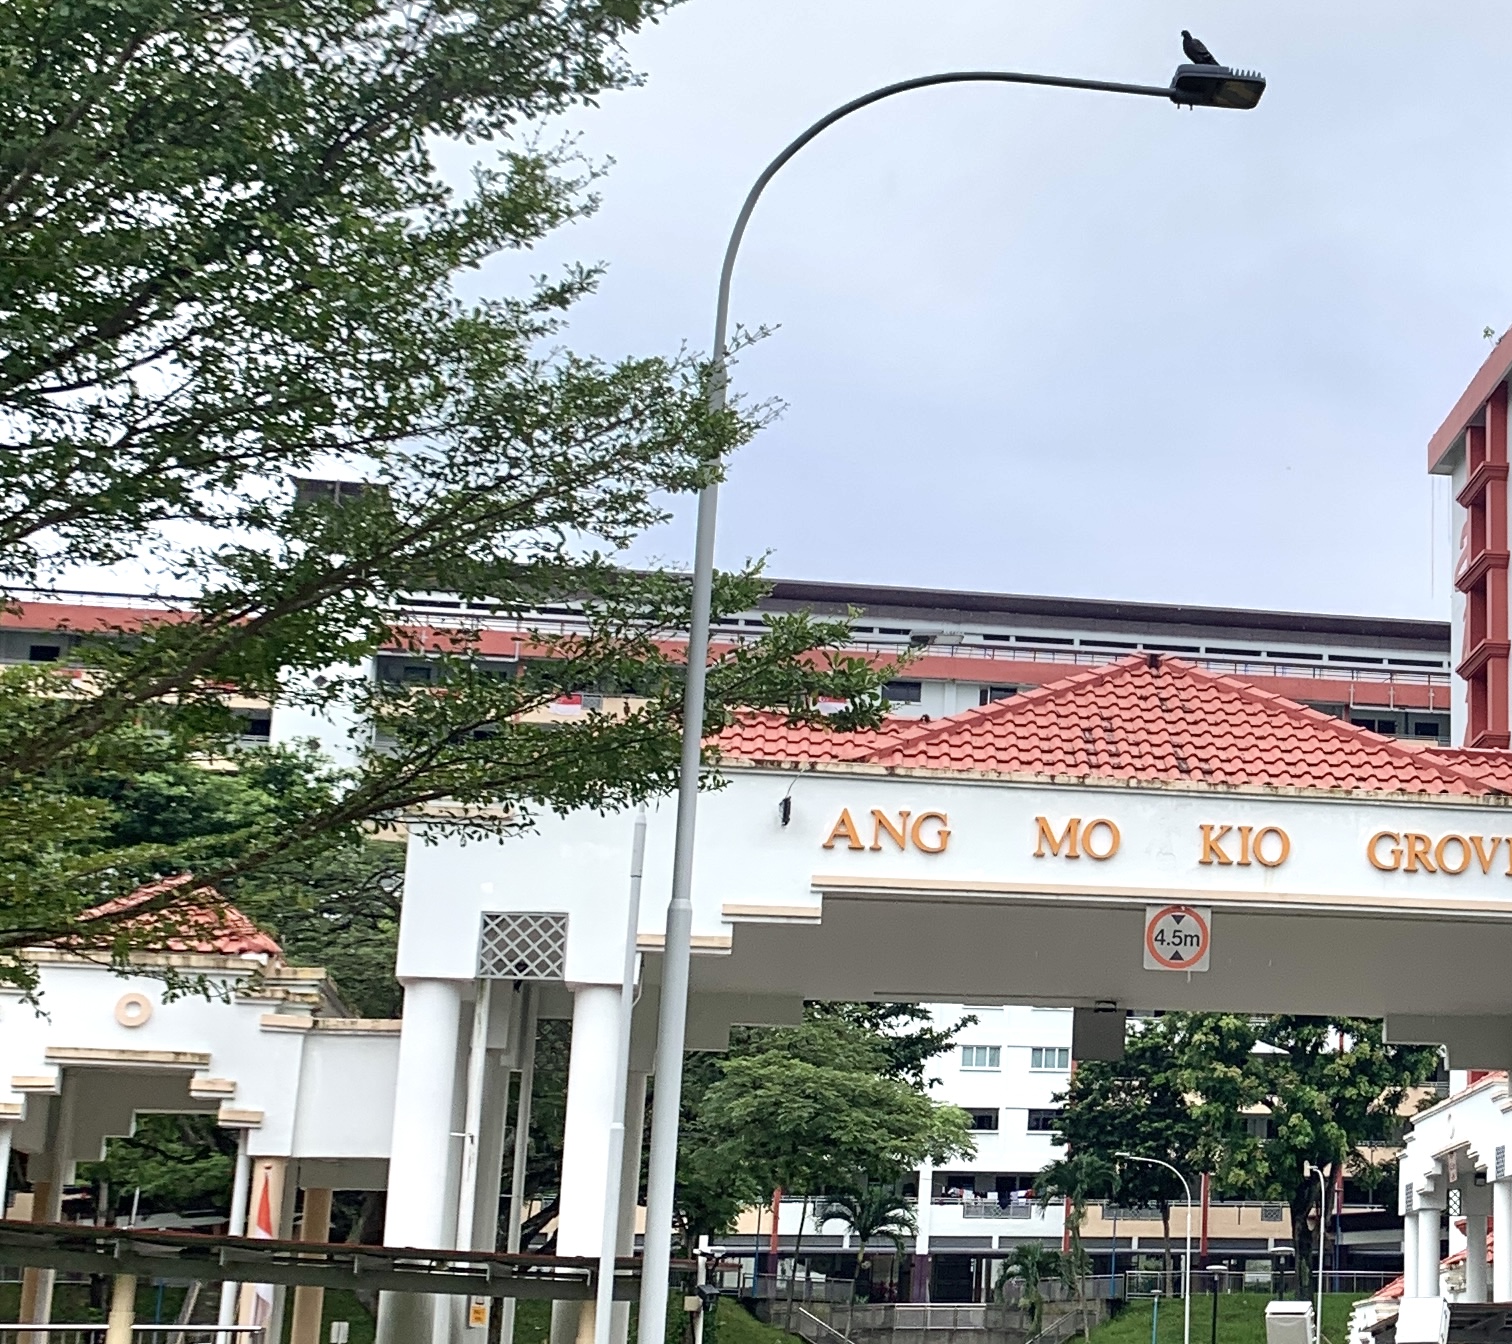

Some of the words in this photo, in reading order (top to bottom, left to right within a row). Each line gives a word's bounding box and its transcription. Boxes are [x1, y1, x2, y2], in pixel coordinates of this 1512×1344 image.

[822, 808, 952, 854] ANG
[1034, 816, 1121, 860] MO
[1199, 824, 1290, 867] KIO
[1154, 928, 1200, 947] 4.5m
